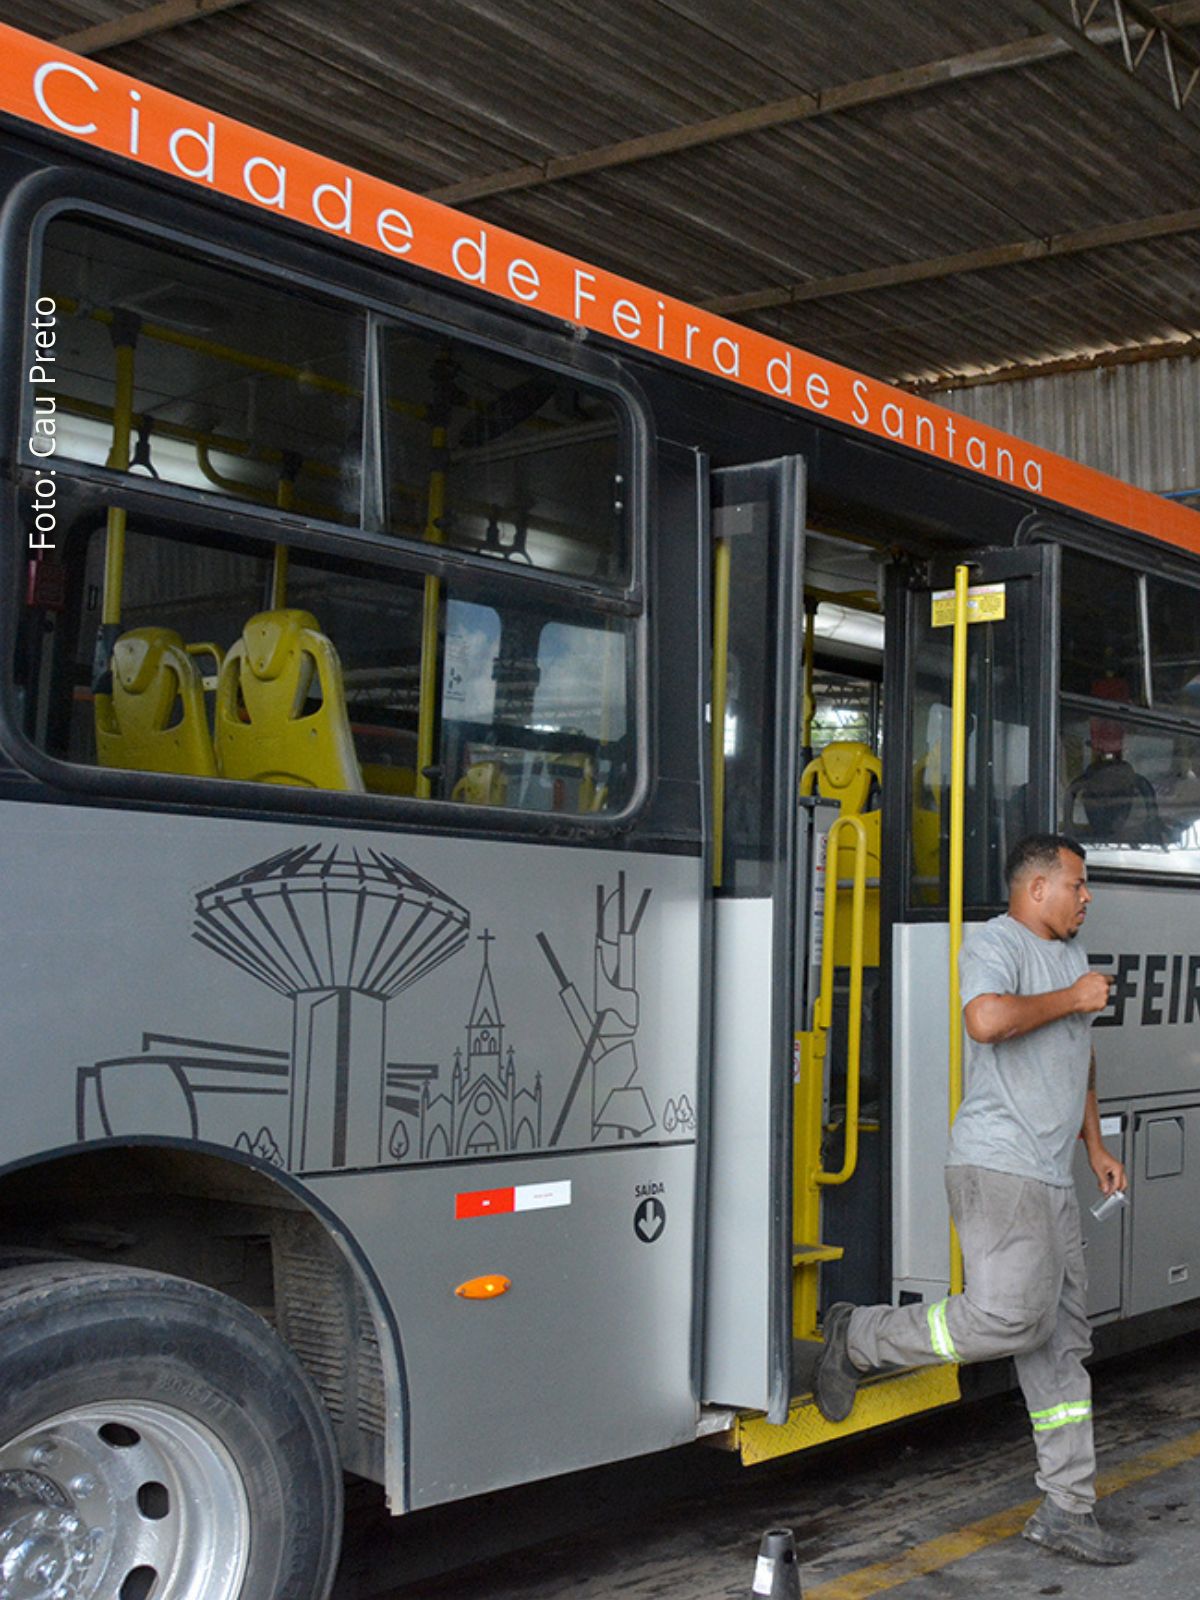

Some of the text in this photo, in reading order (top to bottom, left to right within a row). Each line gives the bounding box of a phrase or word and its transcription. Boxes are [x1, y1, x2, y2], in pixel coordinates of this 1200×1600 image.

[33, 62, 1042, 491] Cidade de Feira de Santana
[634, 1180, 666, 1198] SAÍDA
